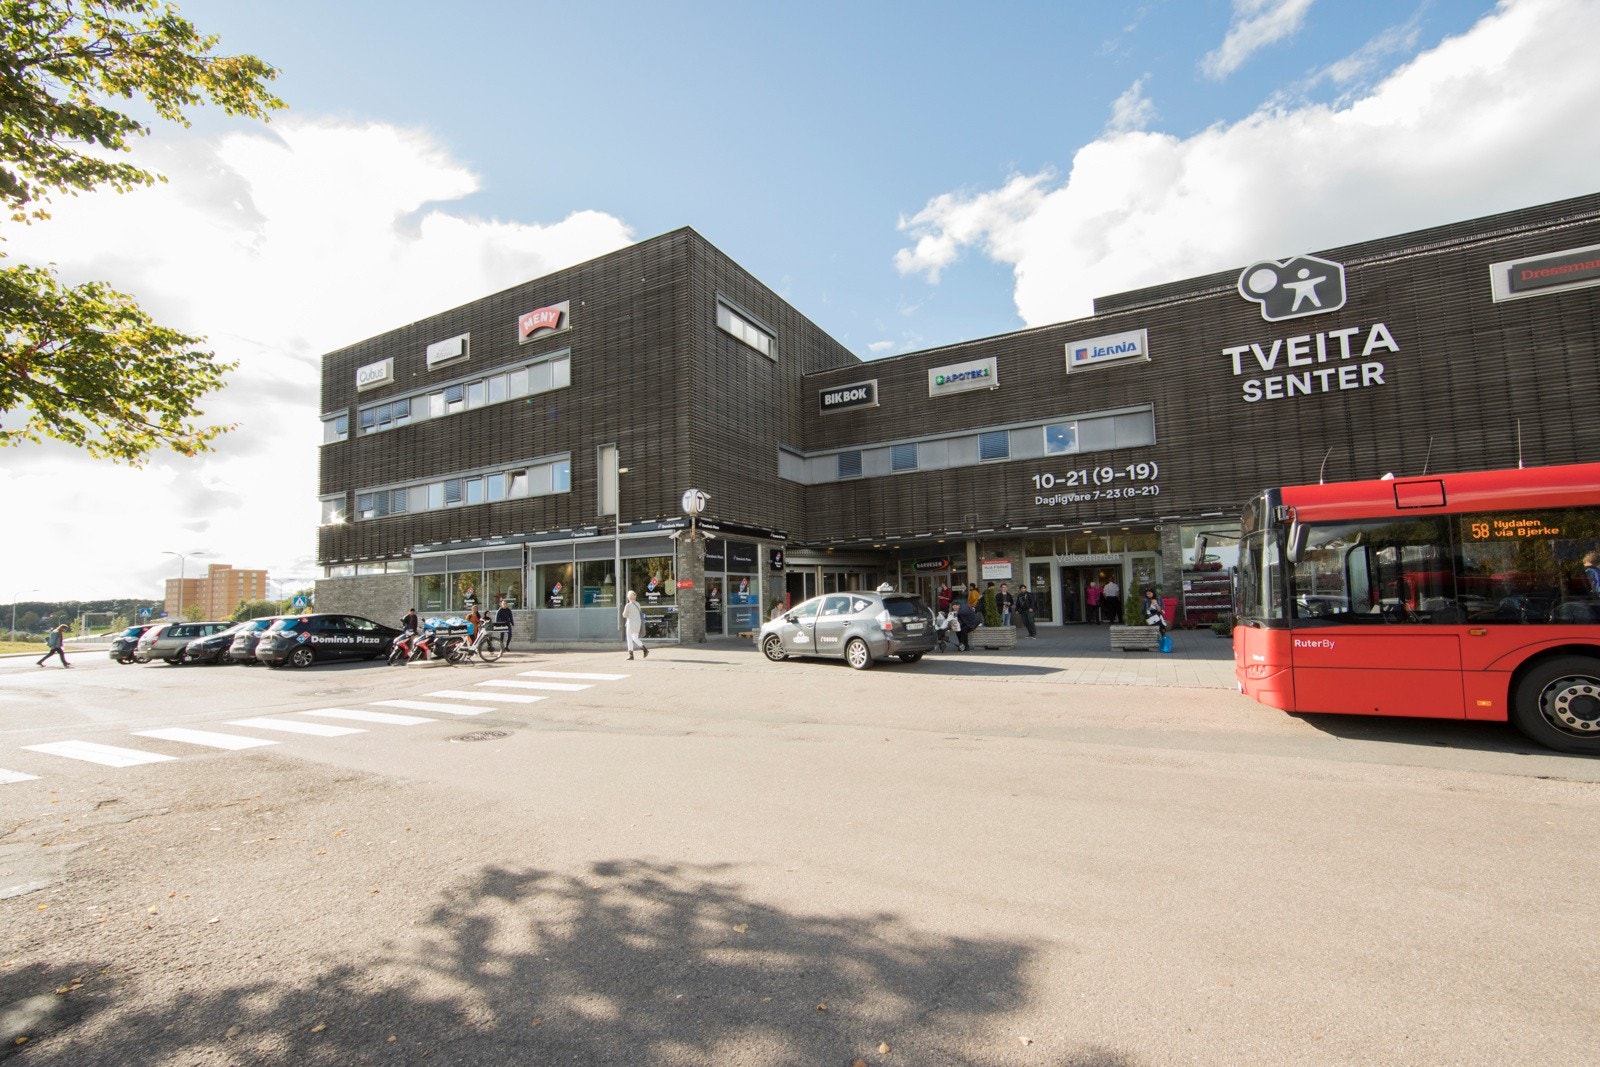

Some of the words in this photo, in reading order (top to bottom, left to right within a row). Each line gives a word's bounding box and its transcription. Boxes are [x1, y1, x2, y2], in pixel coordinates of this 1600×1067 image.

[523, 311, 556, 331] MENY
[1222, 322, 1400, 376] TVEITA
[359, 367, 384, 383] Qubus
[944, 369, 983, 384] APOTEK
[1242, 361, 1386, 403] SENTER
[824, 391, 843, 406] BIK
[843, 386, 867, 403] BOK
[1031, 469, 1088, 490] 10-21
[1093, 461, 1159, 486] (9-19)
[1034, 493, 1092, 507] Dagligvare
[1092, 488, 1121, 500] 7-23
[1123, 484, 1160, 499] (8-21)
[1471, 522, 1490, 539] 58
[1493, 519, 1541, 529] Nydalen
[1494, 529, 1514, 537] via
[1517, 526, 1560, 538] Bjerke
[915, 561, 943, 569] NARVESEN
[1055, 552, 1121, 563] Velkommen
[311, 635, 355, 644] Domino's
[356, 635, 380, 644] Pizza
[1294, 639, 1335, 649] RuterBy
